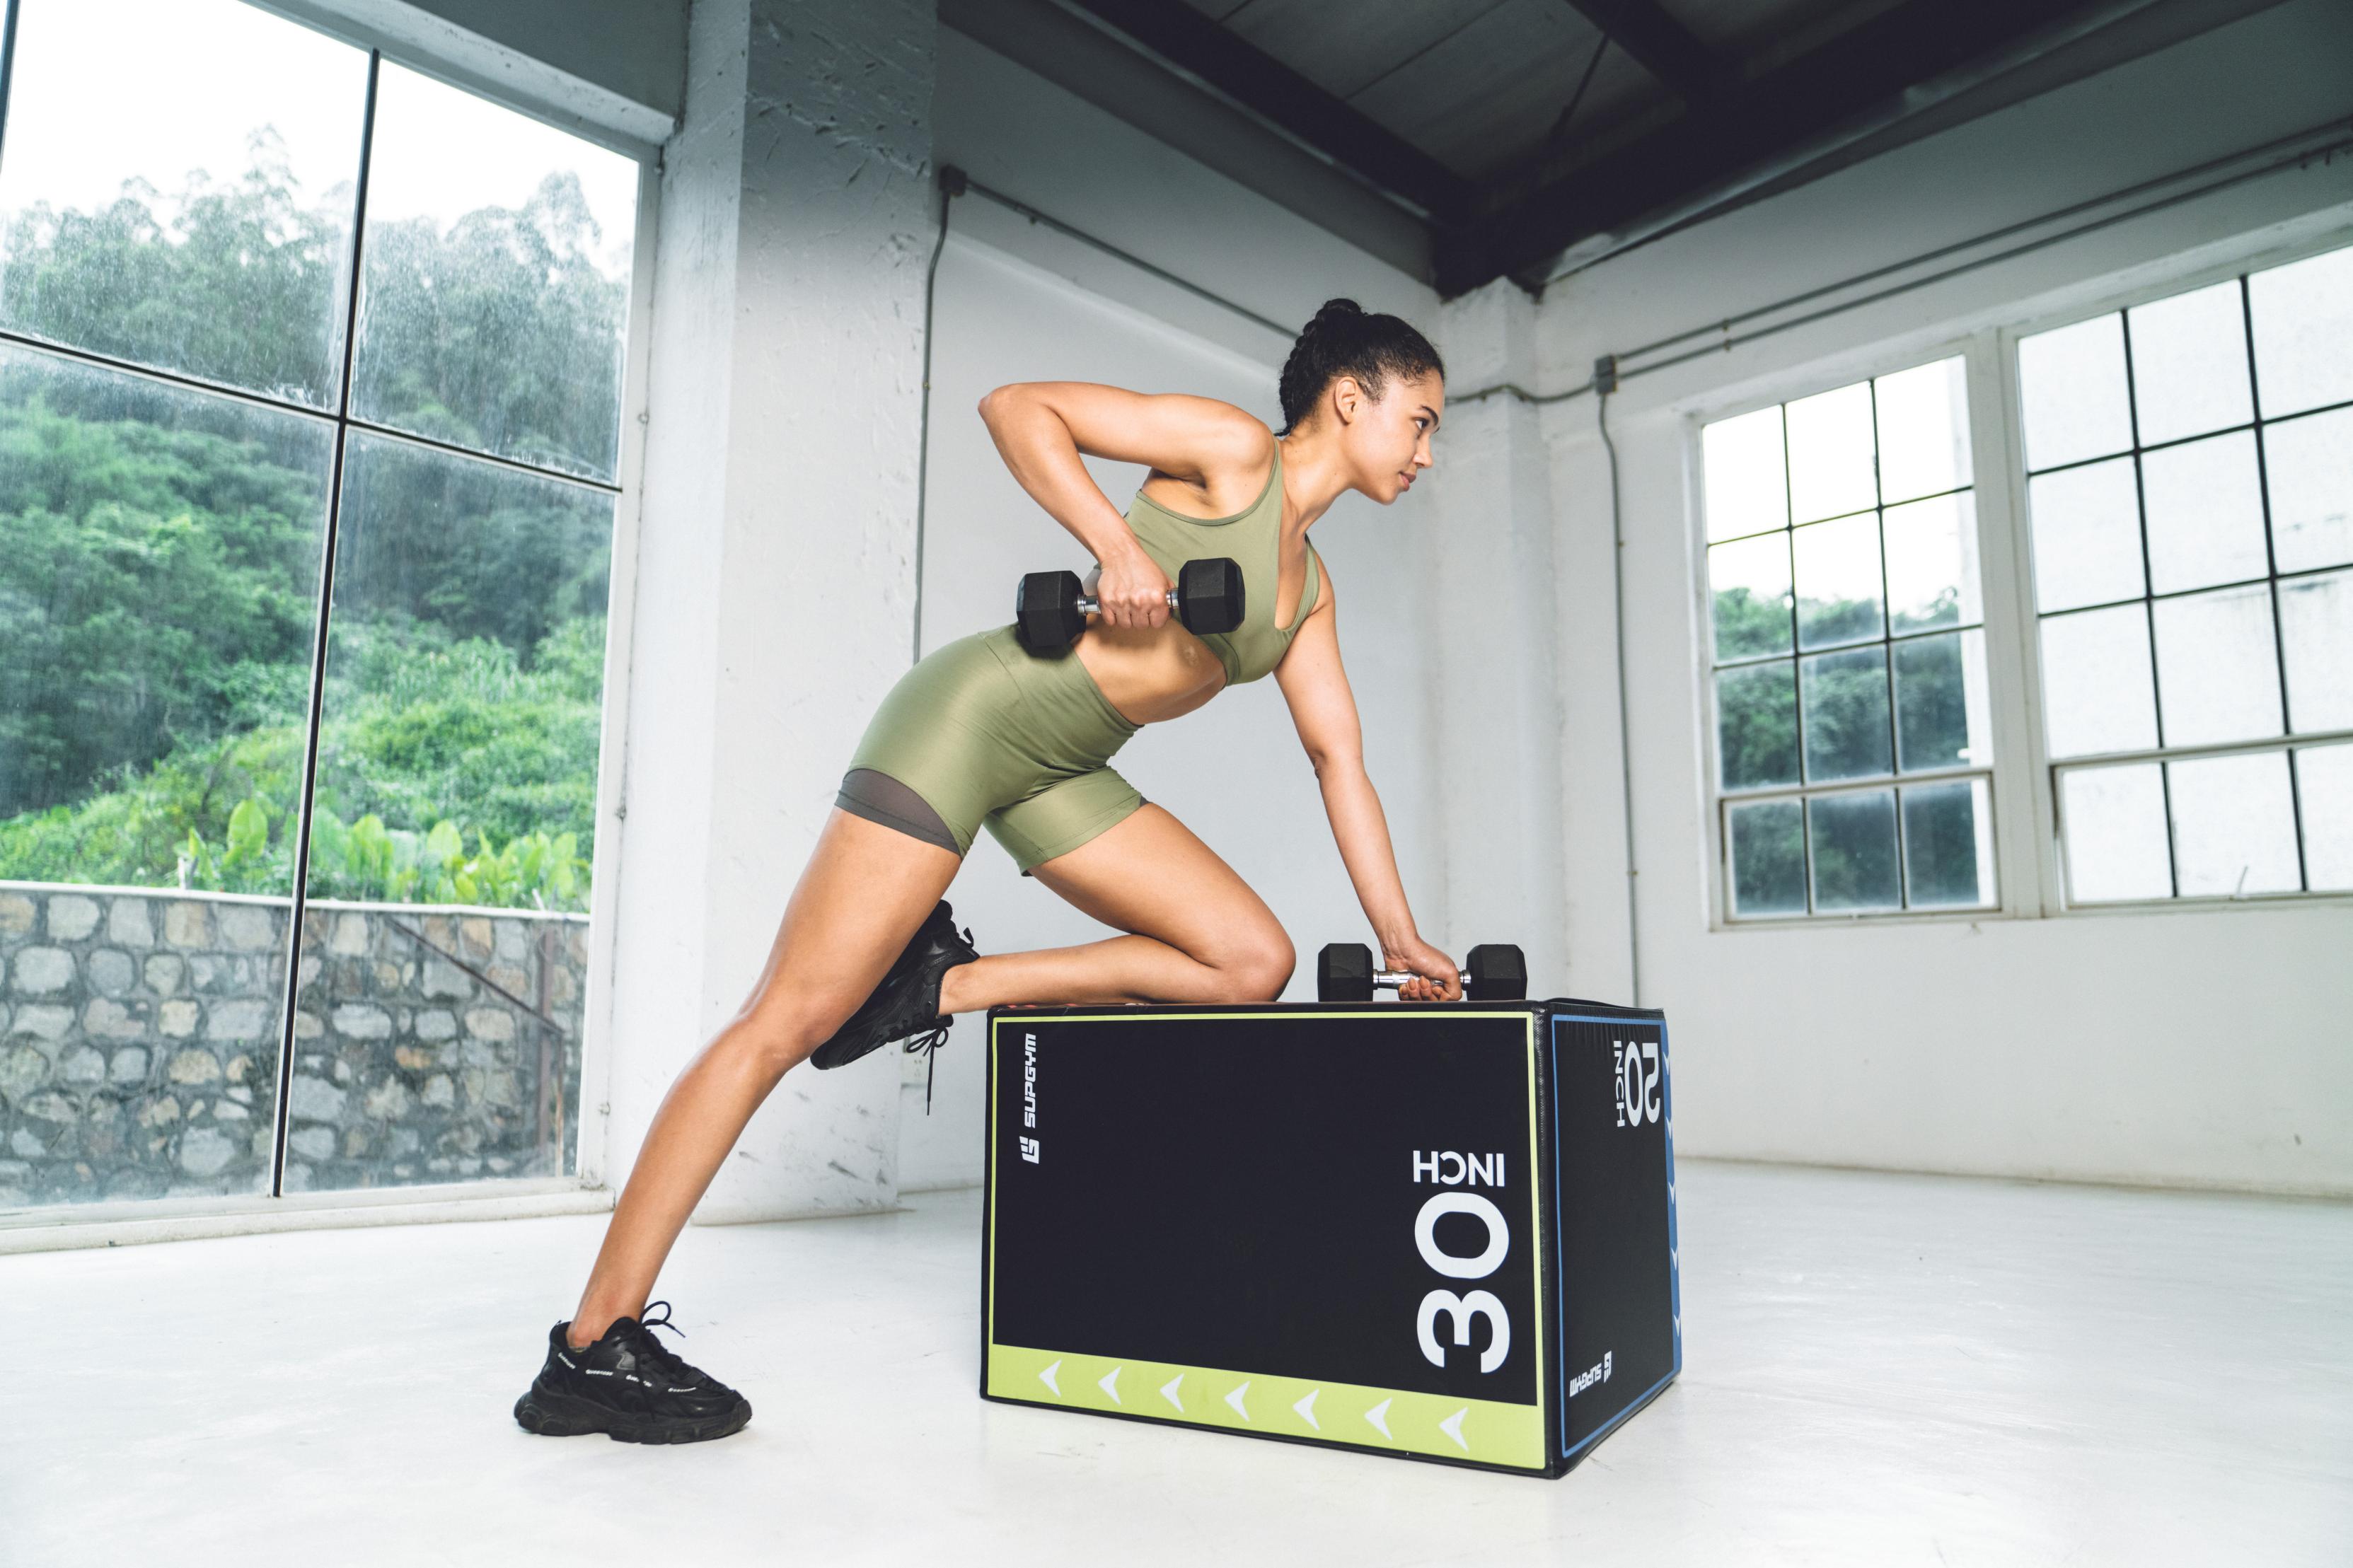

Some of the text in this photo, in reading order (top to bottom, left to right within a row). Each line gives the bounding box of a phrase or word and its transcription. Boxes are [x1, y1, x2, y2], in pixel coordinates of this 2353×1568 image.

[1024, 1033, 1036, 1129] SUPGYM
[1613, 1040, 1626, 1127] INCH
[1624, 1041, 1660, 1127] 20
[1413, 1150, 1505, 1187] INCH
[1414, 1192, 1510, 1374] 30
[1569, 1362, 1602, 1398] SUPGYM
